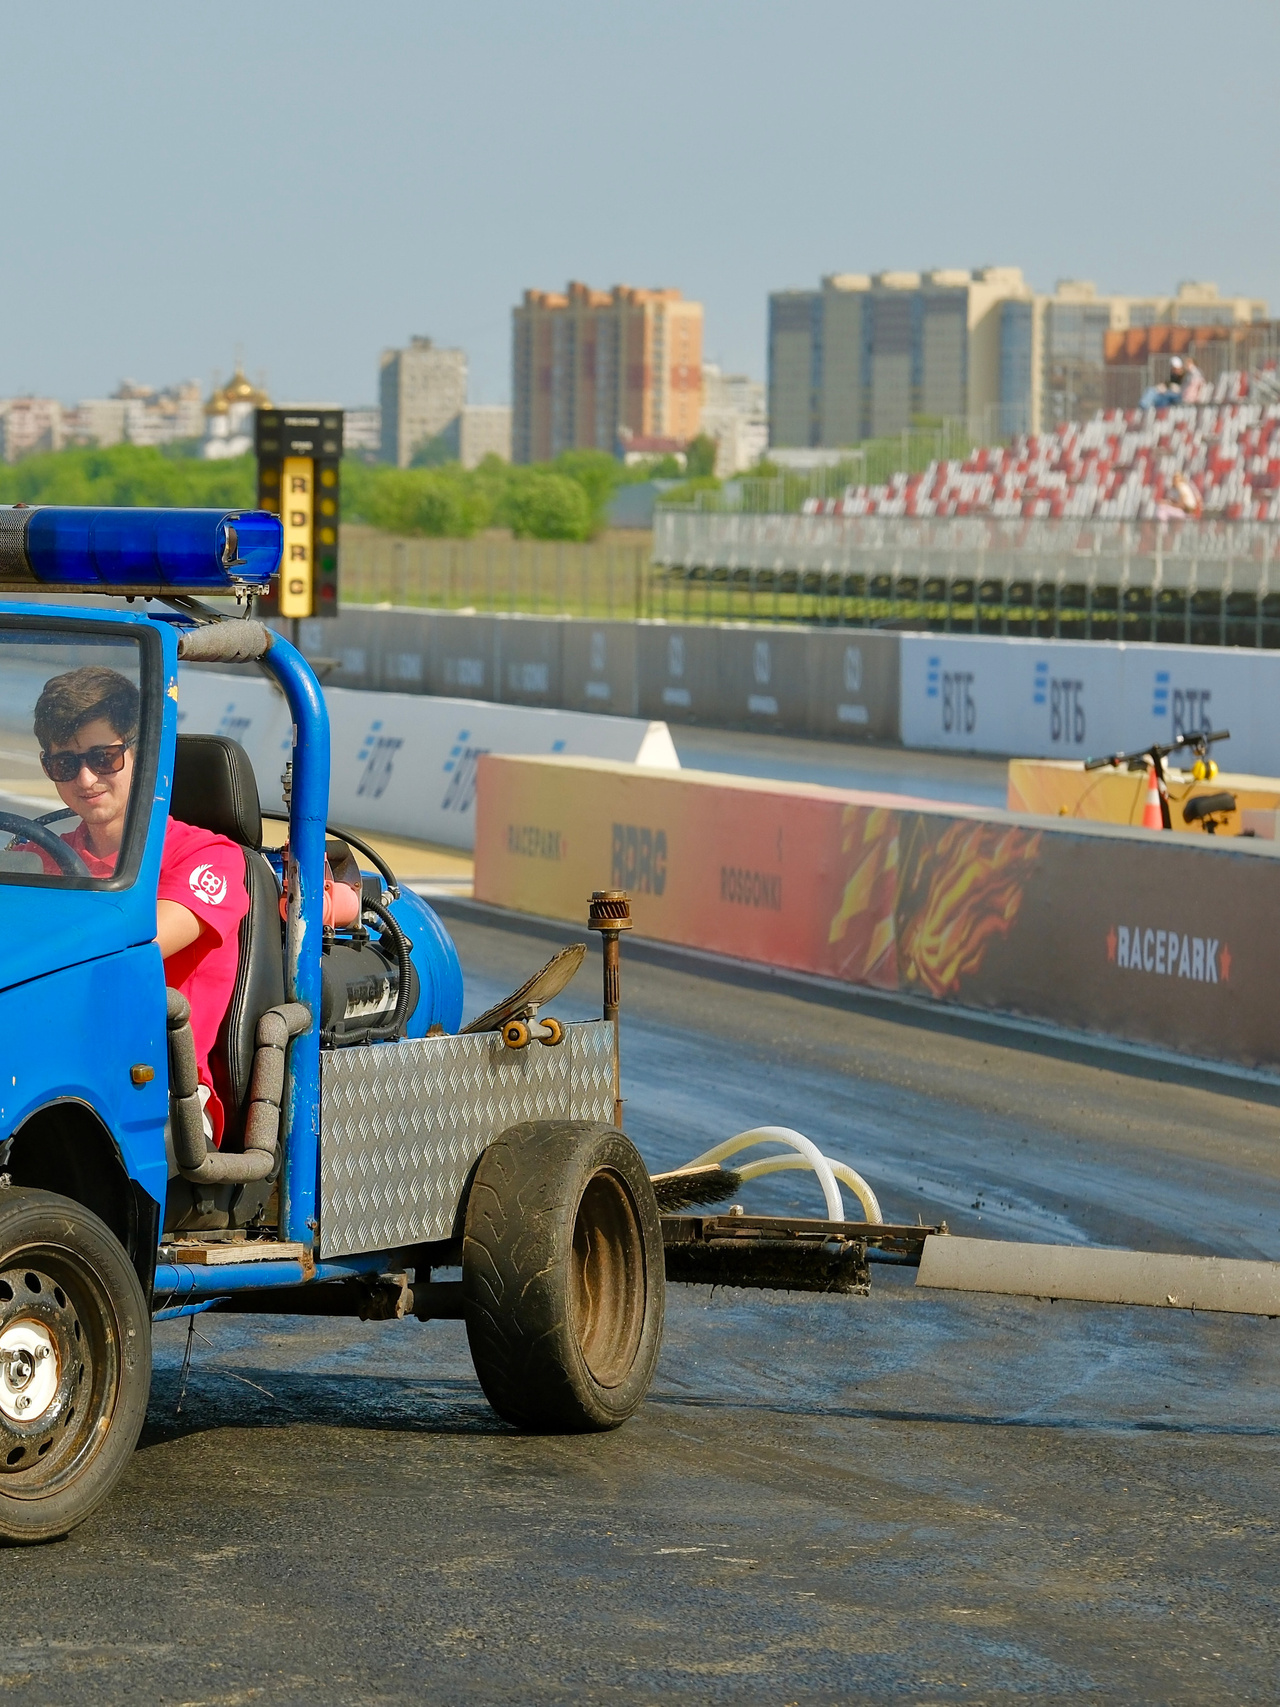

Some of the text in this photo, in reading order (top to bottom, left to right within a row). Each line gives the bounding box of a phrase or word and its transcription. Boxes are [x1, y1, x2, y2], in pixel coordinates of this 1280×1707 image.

[288, 476, 307, 595] RDRC
[942, 671, 976, 733] ВТБ
[1050, 677, 1086, 743] ВТБ
[611, 822, 668, 896] RDRC
[720, 865, 783, 912] ROSGONKI
[1117, 925, 1219, 983] RACEPARK
